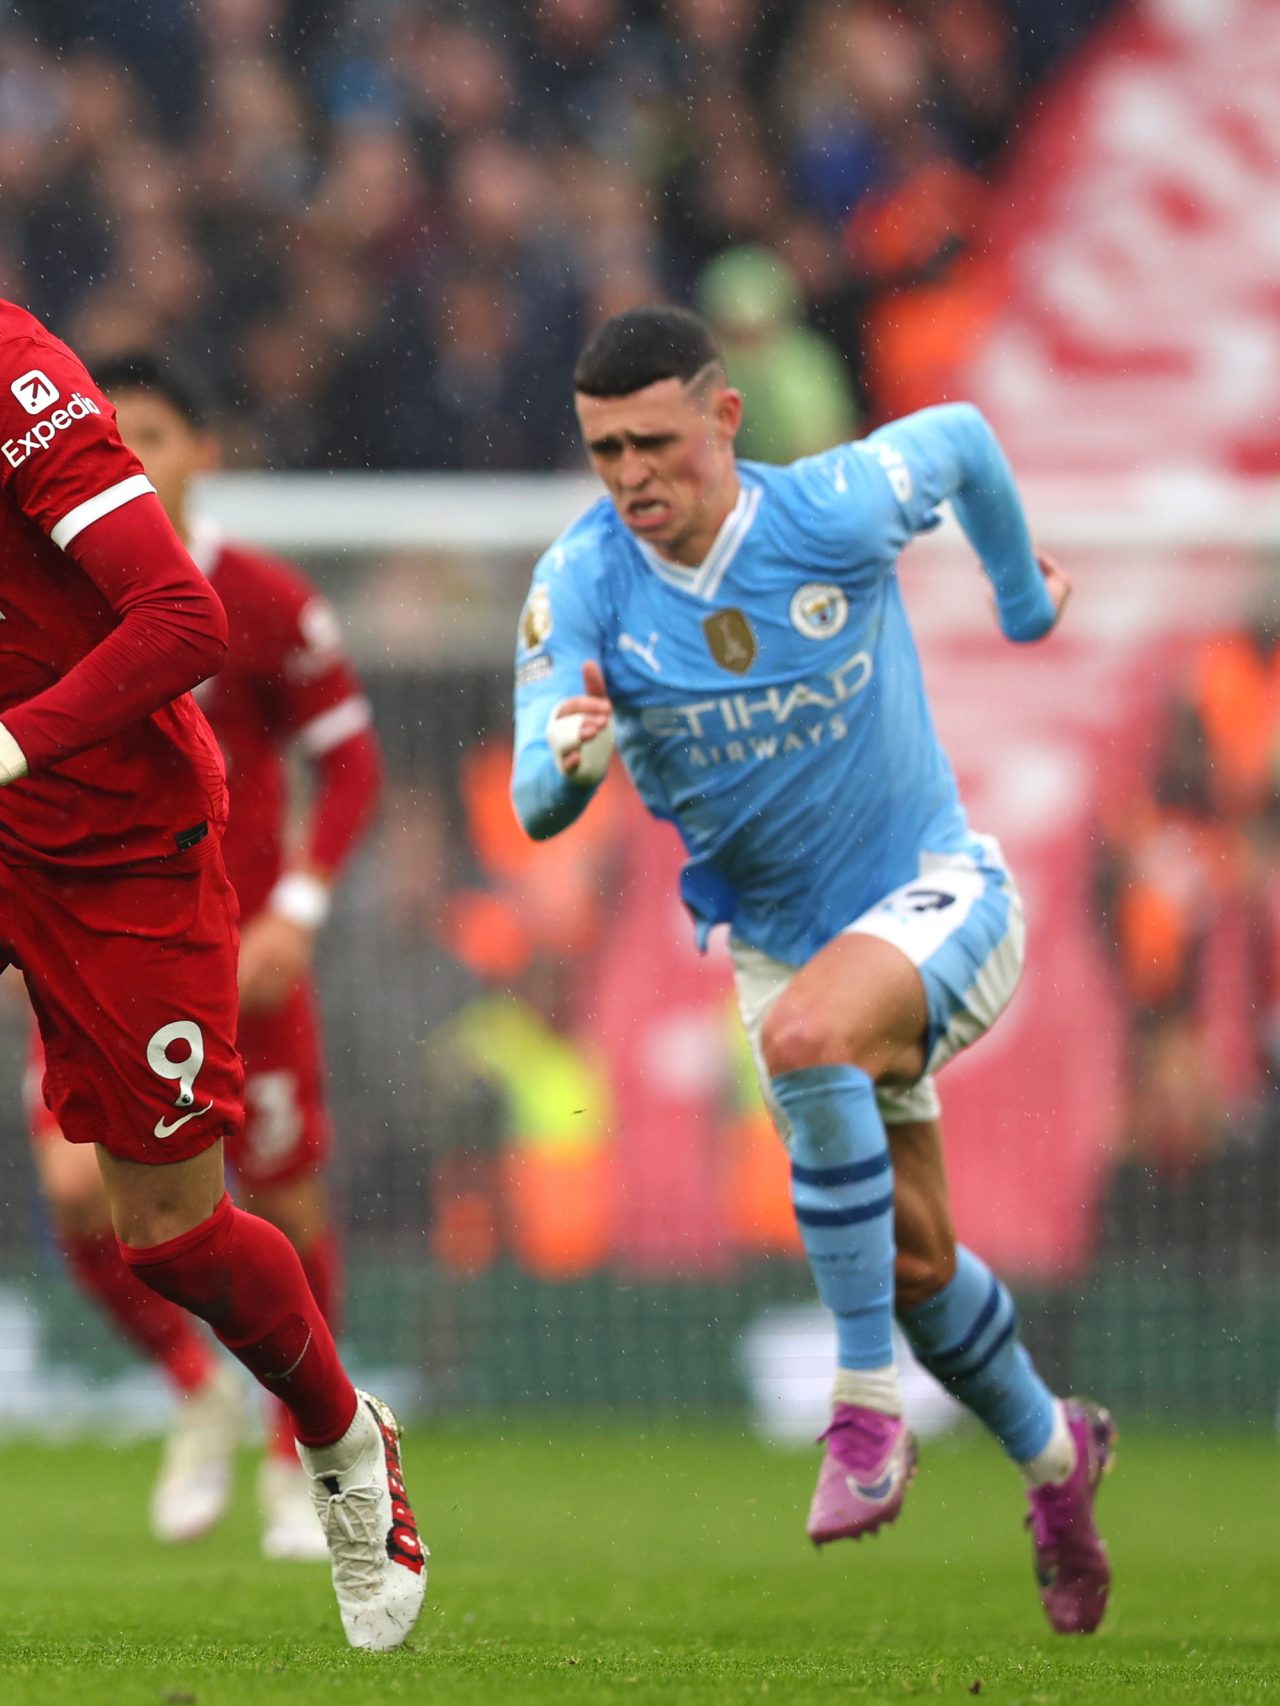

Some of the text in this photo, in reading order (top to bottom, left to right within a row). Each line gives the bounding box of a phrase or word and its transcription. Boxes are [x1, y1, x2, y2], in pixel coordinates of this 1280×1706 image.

[641, 650, 874, 738] ETIHAD
[689, 714, 848, 767] AIRWAYS
[146, 1020, 204, 1107] 9
